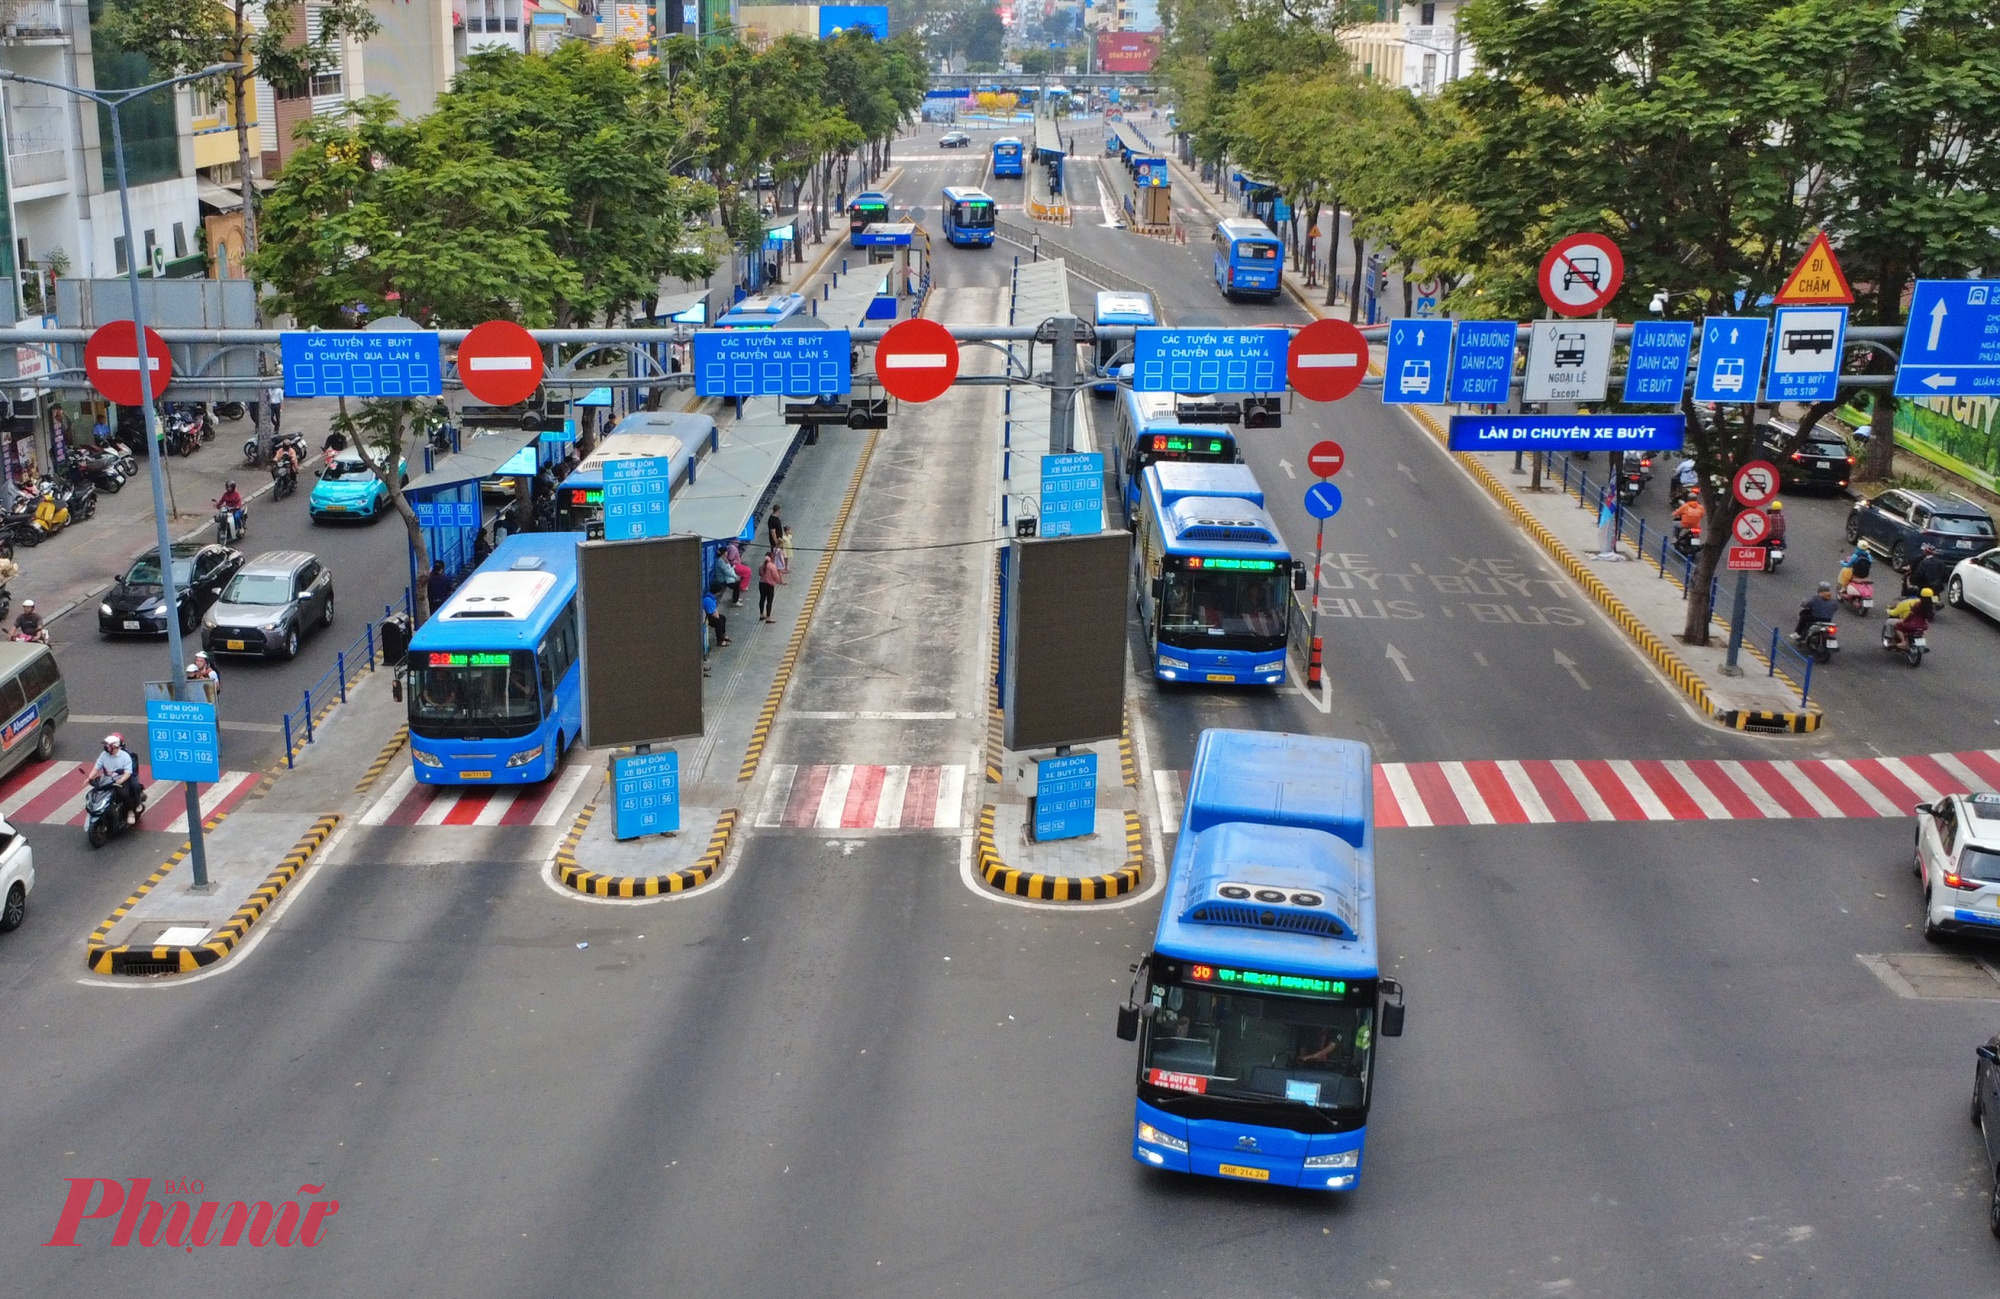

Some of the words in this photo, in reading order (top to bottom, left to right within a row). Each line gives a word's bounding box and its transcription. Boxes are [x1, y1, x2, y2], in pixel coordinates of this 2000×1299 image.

[1812, 259, 1824, 272] ĐI
[1798, 276, 1831, 296] CHẬM
[308, 336, 327, 348] CÁC
[332, 335, 364, 348] TUYẾN
[370, 338, 382, 348] XE
[388, 336, 413, 348] BUÝT
[720, 336, 740, 347] CÁC
[745, 334, 776, 346] TUYẾN
[781, 337, 794, 346] XE
[798, 336, 824, 346] BUÝT
[1162, 333, 1180, 344] CÁC
[1186, 332, 1217, 344] TUYẾN
[1222, 336, 1234, 344] XE
[1240, 333, 1266, 344] BUÝT
[1638, 329, 1656, 348] LÀN
[320, 348, 358, 360] CHUYỂN
[364, 352, 383, 360] QUA
[388, 350, 410, 360] LÀN
[414, 352, 421, 360] 6
[730, 347, 768, 360] CHUYỂN
[773, 350, 792, 360] QUA
[798, 348, 819, 359] LÀN
[822, 350, 829, 359] 5
[1172, 345, 1208, 358] CHUYỂN
[1214, 348, 1234, 358] QUA
[1240, 346, 1260, 358] LÀN
[1262, 349, 1269, 357] 4
[1461, 352, 1486, 370] DÀNH
[1486, 356, 1504, 370] CHO
[1636, 353, 1660, 370] DÀNH
[1662, 356, 1680, 370] CHO
[1548, 372, 1574, 384] NGOẠI
[1576, 370, 1588, 384] LỆ
[1796, 376, 1806, 384] XE
[1973, 376, 1996, 388] QUẬN
[1462, 378, 1474, 392] XE
[1474, 374, 1498, 392] BUÝT
[1636, 379, 1650, 393] XE
[1650, 376, 1673, 393] BUÝT
[1551, 388, 1580, 398] Except
[1800, 387, 1818, 396] STOP
[1952, 395, 2000, 435] CITY
[1479, 426, 1511, 440] LÀN
[1594, 428, 1614, 438] XE
[1616, 425, 1656, 438] BUÝT
[612, 486, 622, 495] 01
[631, 484, 642, 493] 03
[651, 482, 660, 492] 19
[572, 490, 586, 504] 20
[612, 506, 622, 514] 45
[632, 504, 642, 512] 53
[652, 502, 660, 511] 56
[1305, 552, 1377, 570] XE
[1451, 556, 1525, 576] XE
[1316, 598, 1425, 620] BUS
[1468, 602, 1586, 627] BUS
[158, 712, 168, 720] XE
[170, 712, 190, 720] BUÝT
[156, 731, 168, 740] 20
[177, 732, 187, 740] 34
[197, 732, 208, 741] 38
[158, 750, 168, 759] 39
[178, 751, 188, 760] 75
[196, 752, 212, 762] 102
[636, 766, 656, 775] BUÝT
[1056, 768, 1077, 778] BUÝT
[643, 781, 652, 790] 03
[662, 778, 670, 786] 19
[1070, 782, 1077, 790] 31
[624, 784, 634, 792] 01
[624, 800, 635, 808] 45
[643, 798, 653, 806] 53
[662, 794, 672, 804] 56
